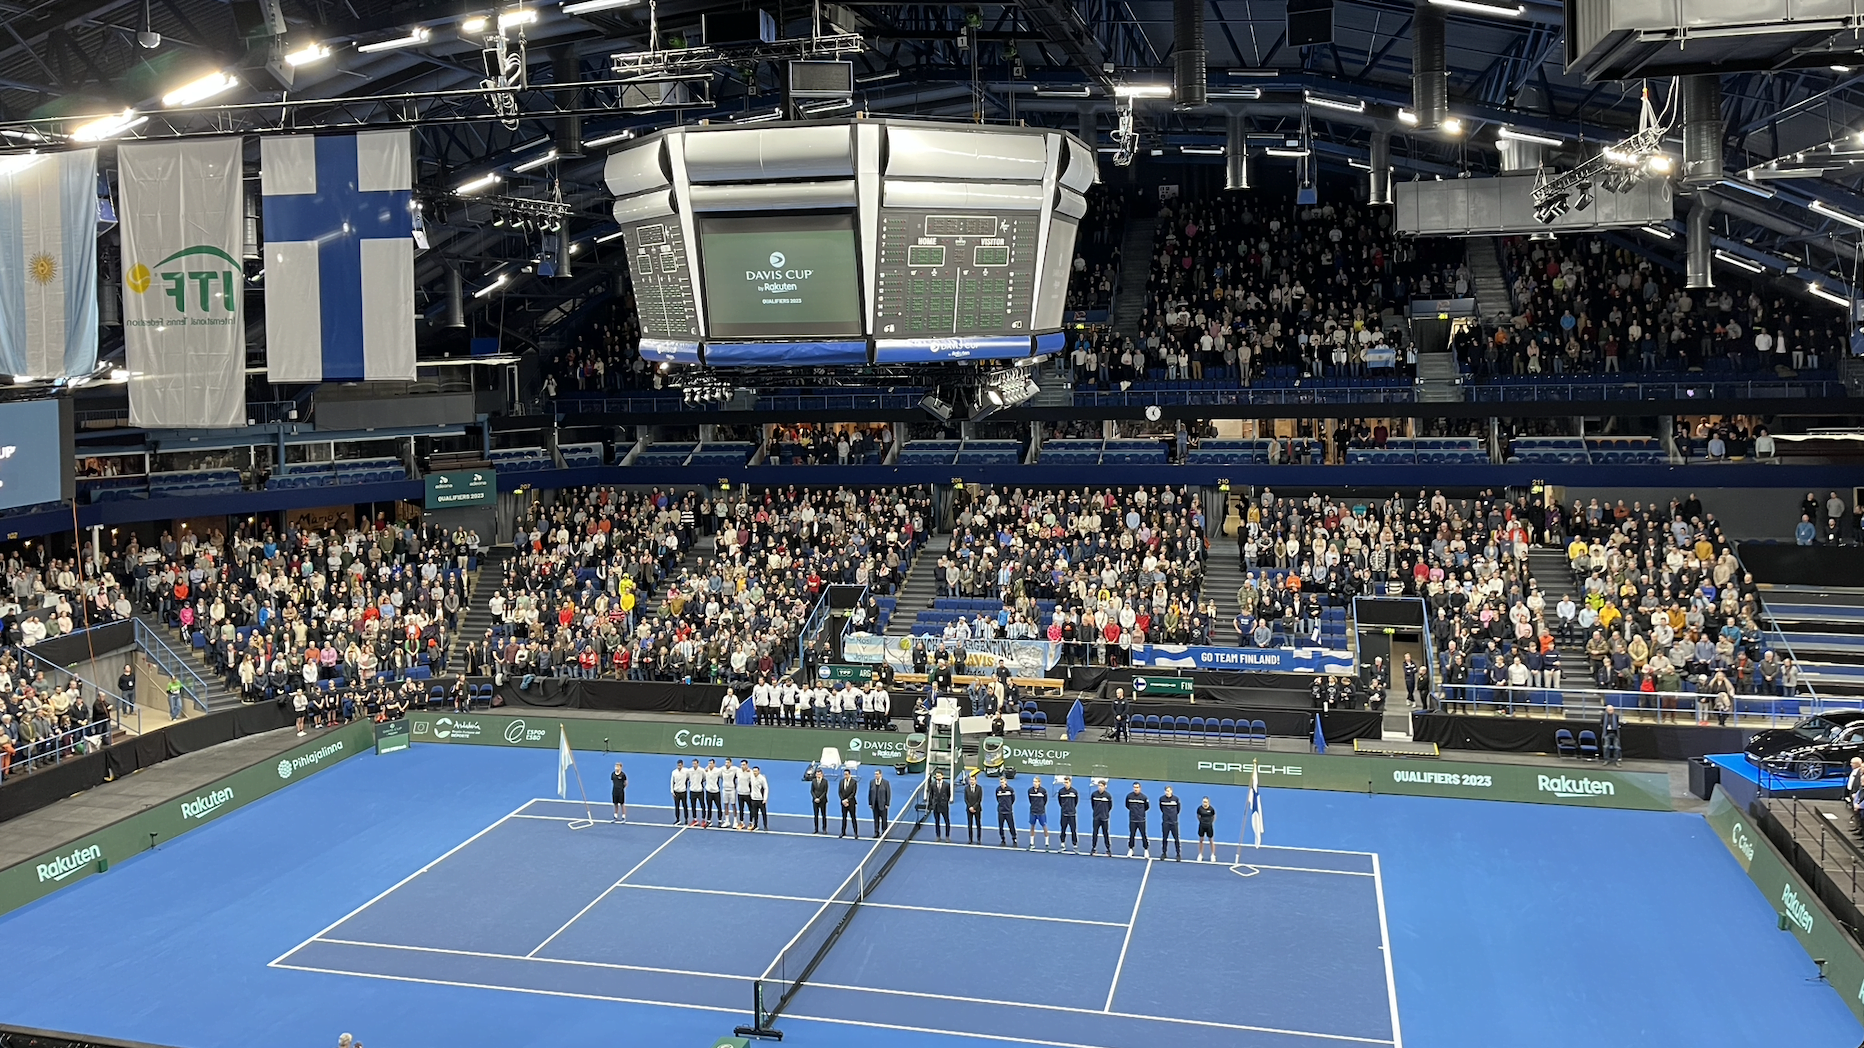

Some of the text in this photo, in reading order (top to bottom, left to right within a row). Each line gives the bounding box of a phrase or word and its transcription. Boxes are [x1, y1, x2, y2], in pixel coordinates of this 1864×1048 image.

[917, 237, 937, 246] HOME
[981, 238, 1005, 246] VISITOR
[745, 269, 812, 280] DAVIS CUP
[764, 282, 797, 293] Rakuten
[0, 445, 16, 460] UP
[437, 492, 484, 502] QUALIFIERS 2023
[1201, 652, 1280, 665] GO TEAM FINLAND!
[1180, 681, 1193, 690] FIN
[691, 733, 724, 747] Cinia
[863, 740, 893, 750] DAVIS
[292, 740, 344, 770] Pihlajalinna
[877, 749, 902, 758] Rakuten
[1013, 748, 1070, 759] DAVIS CUP
[1027, 757, 1054, 766] Rakuten
[1197, 761, 1303, 775] PORSCHE
[1393, 770, 1492, 787] QUALIFIERS 2023
[1537, 774, 1615, 797] Rakuten
[181, 786, 235, 819] Rakuten
[1738, 834, 1755, 862] Cinia
[36, 844, 101, 882] Rakuten
[1781, 883, 1814, 934] Rakuten
